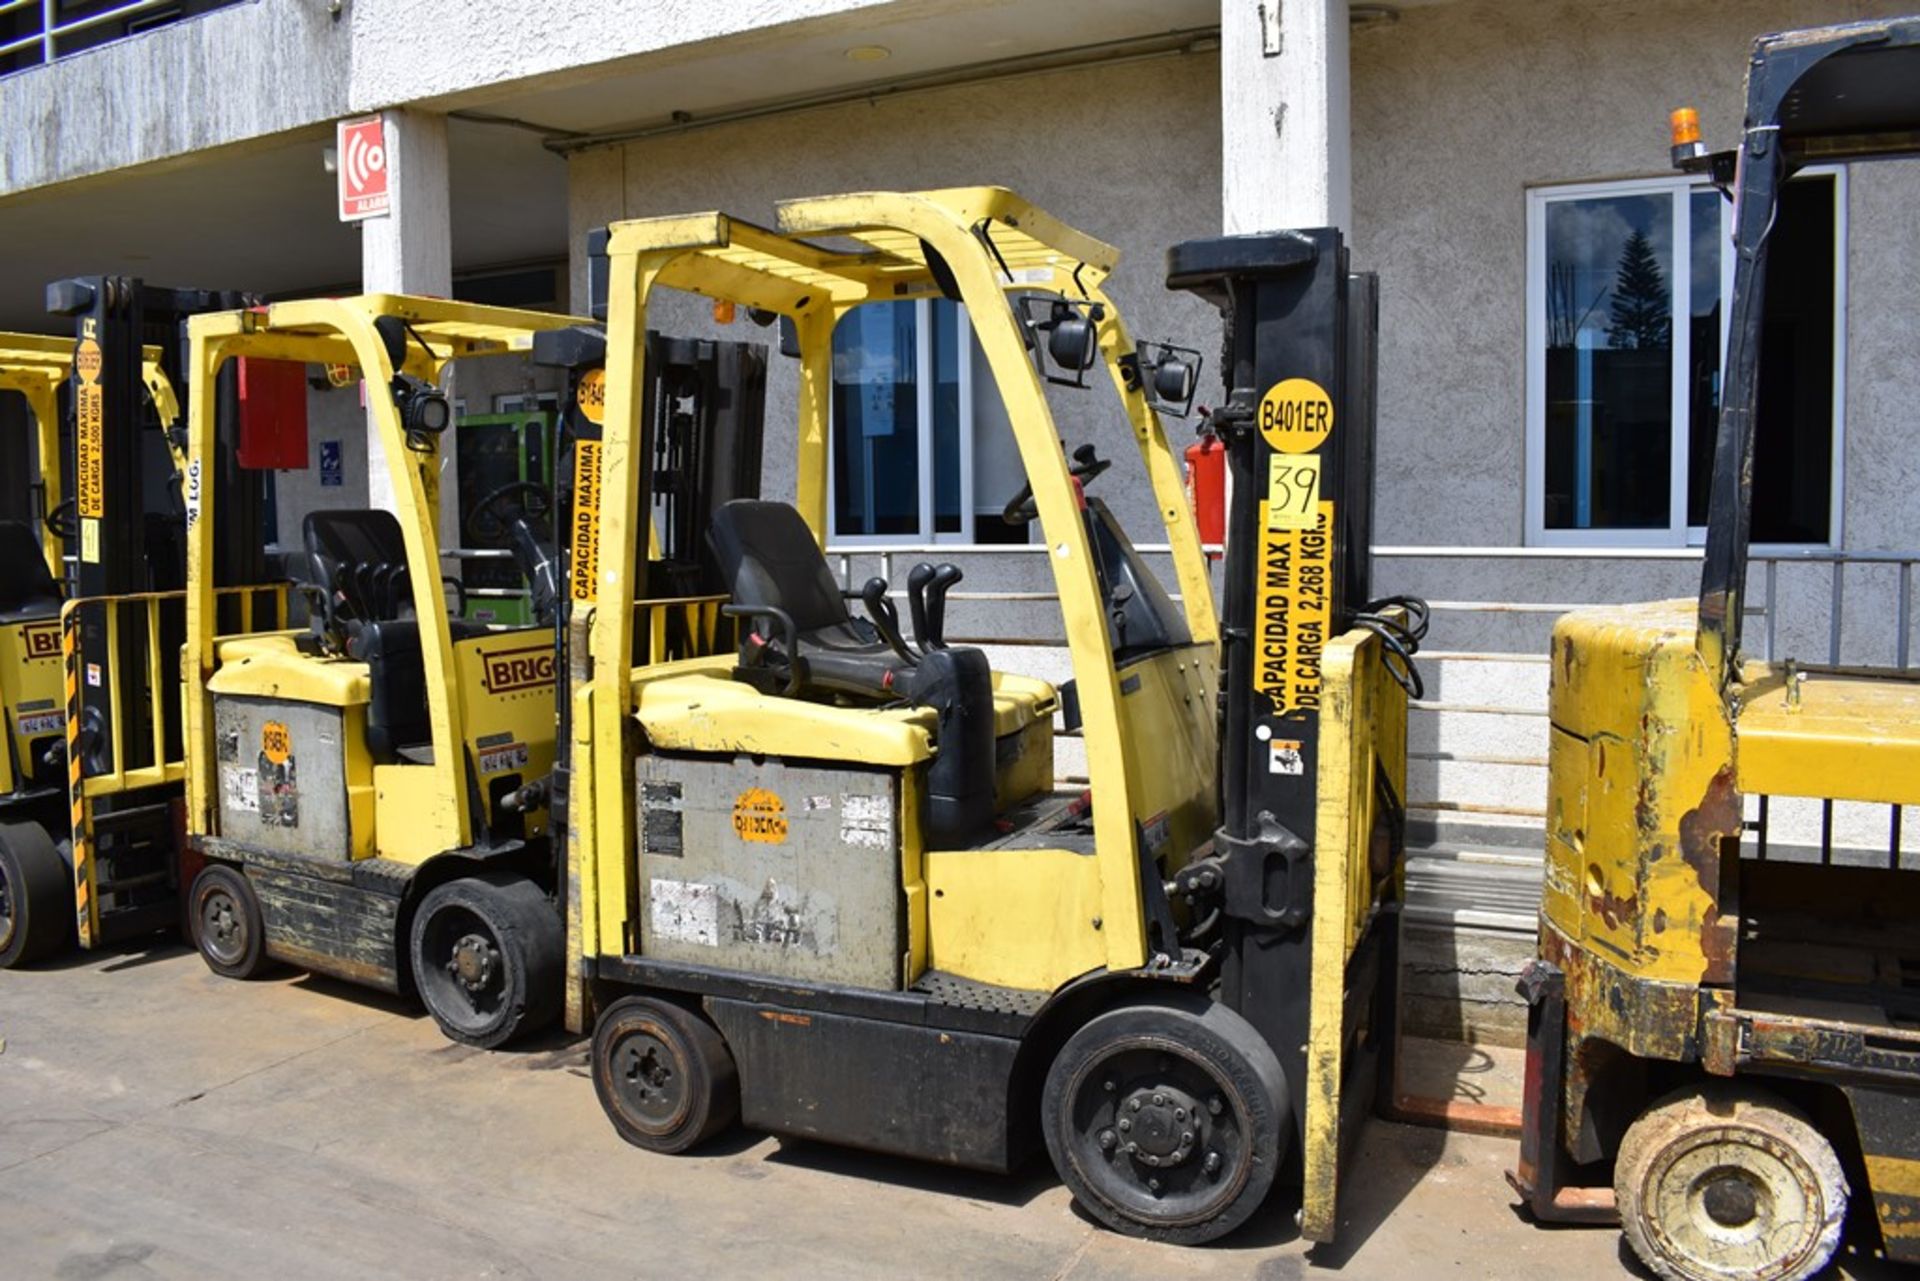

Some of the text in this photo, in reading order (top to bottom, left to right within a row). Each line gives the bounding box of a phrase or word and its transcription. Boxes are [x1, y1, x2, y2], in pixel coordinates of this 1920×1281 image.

[1262, 400, 1329, 432] B401ER
[79, 443, 89, 514] CAPACIDAD
[91, 458, 100, 494] CARGA
[1270, 465, 1317, 514] 39
[91, 496, 100, 511] DE
[575, 512, 592, 600] CAPACIDAD
[1298, 565, 1329, 611] 2,268
[1296, 620, 1322, 680] CARGA
[1295, 685, 1320, 708] DE
